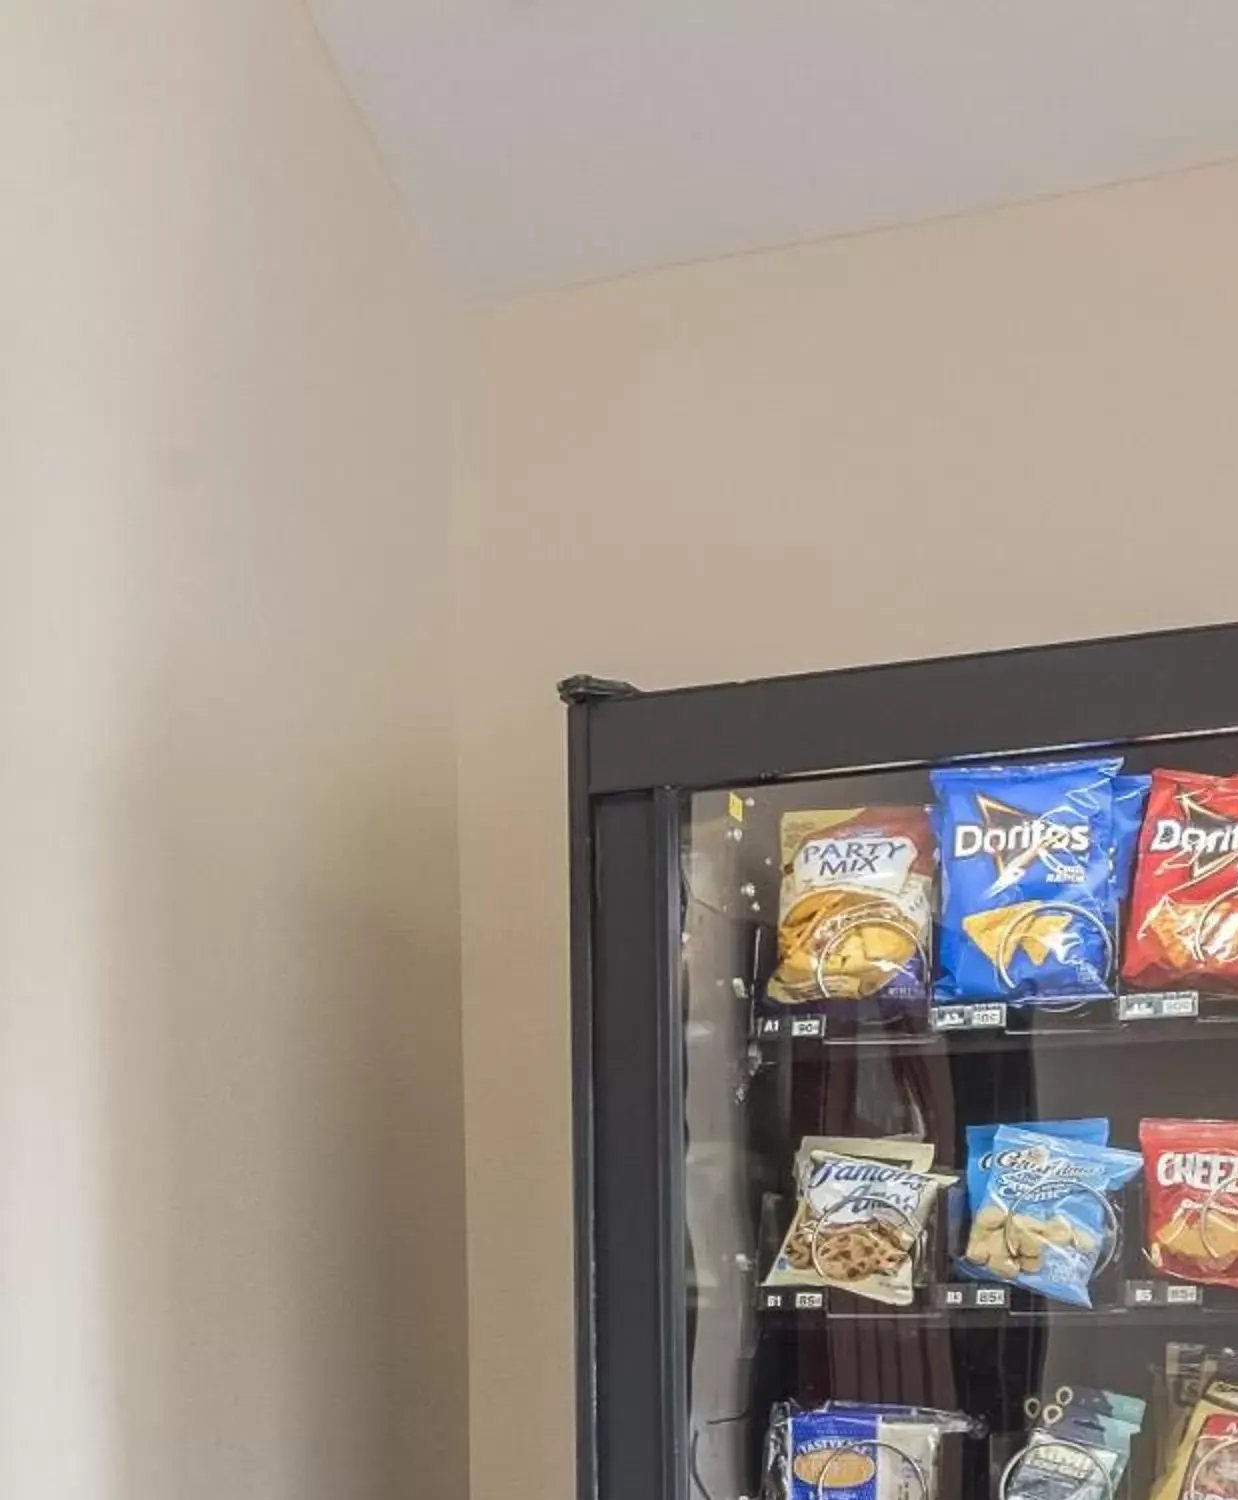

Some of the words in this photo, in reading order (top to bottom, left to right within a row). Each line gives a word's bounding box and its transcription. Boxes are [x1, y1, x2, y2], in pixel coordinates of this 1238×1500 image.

[954, 820, 1090, 858] Doritos
[802, 840, 908, 864] PARTY
[819, 855, 880, 877] MIX
